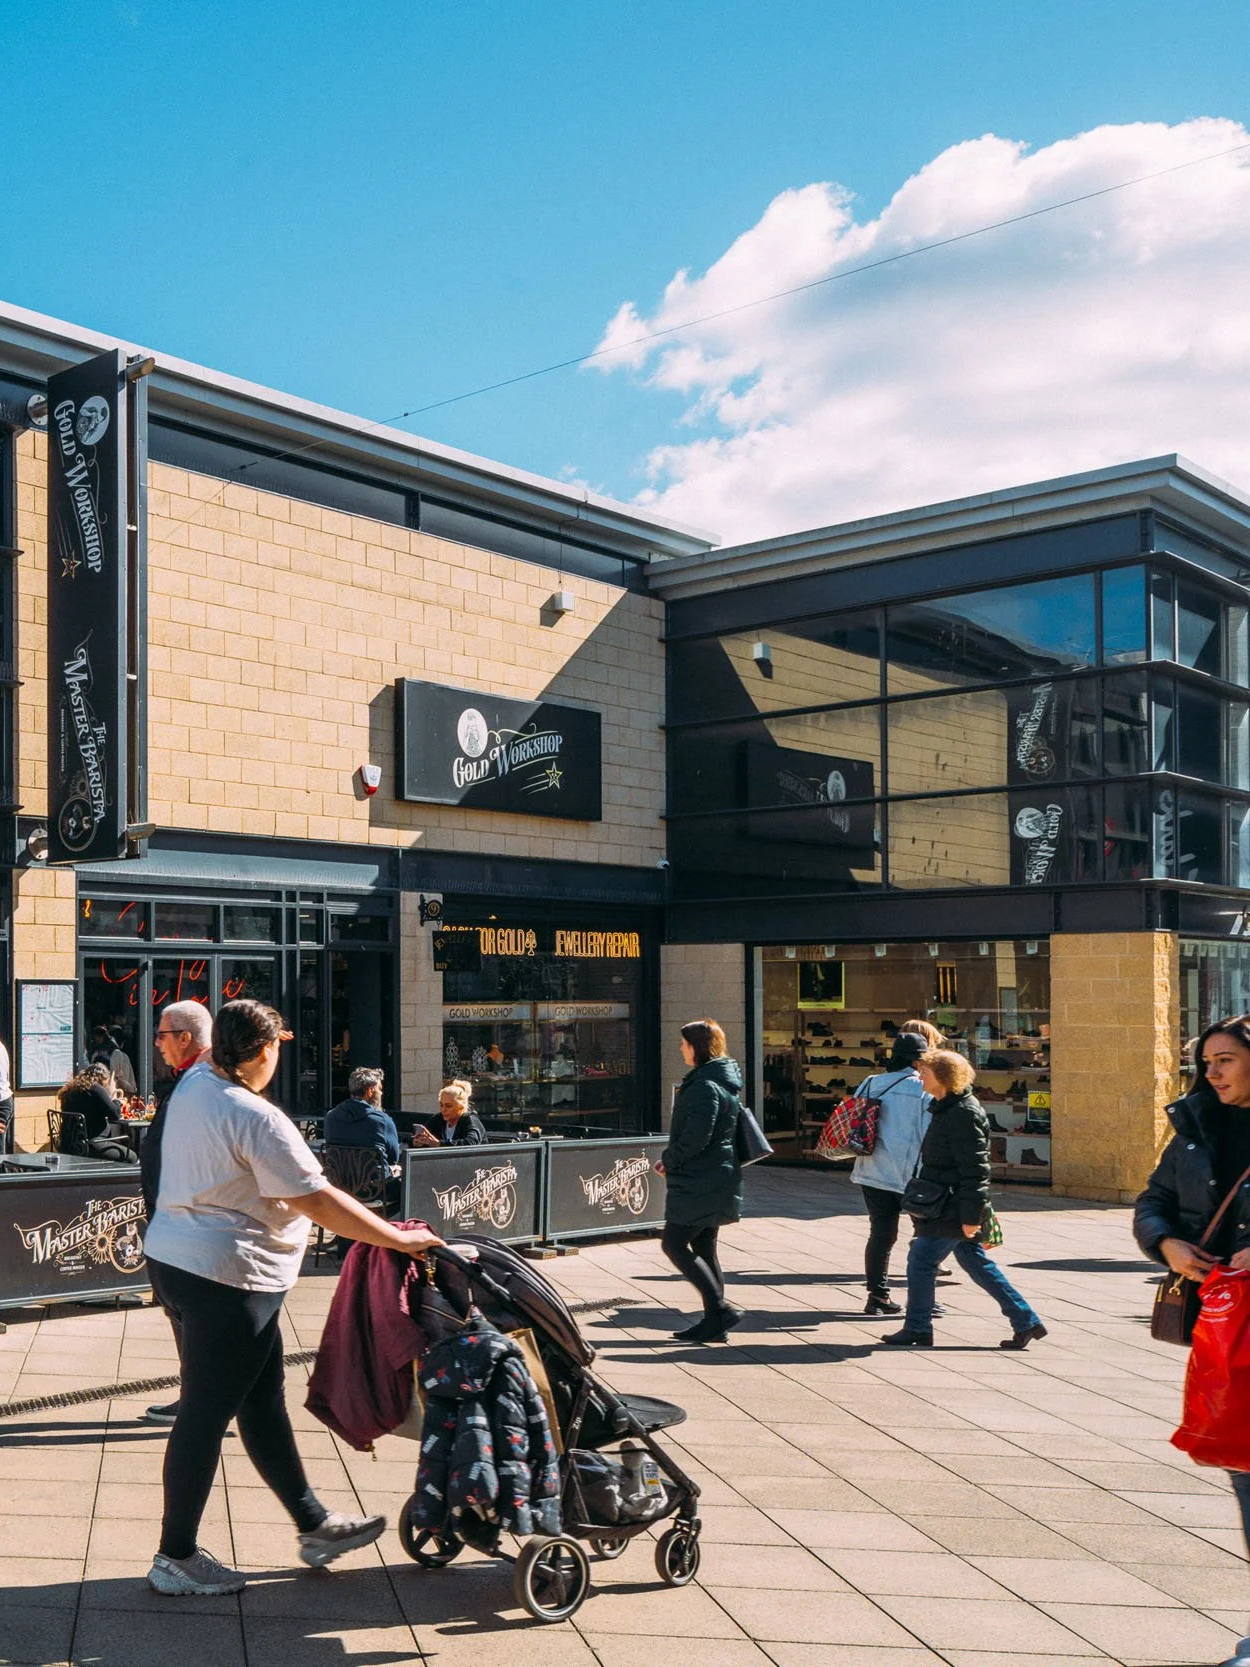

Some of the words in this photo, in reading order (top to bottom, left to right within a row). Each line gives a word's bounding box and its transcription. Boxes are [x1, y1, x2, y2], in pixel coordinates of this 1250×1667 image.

[54, 400, 76, 456] GOLD
[64, 453, 102, 574] WORKSHOP
[63, 647, 89, 737] MASTER
[79, 736, 105, 824] BARISTA
[93, 721, 107, 745] THE
[452, 757, 490, 789] GOLD
[490, 734, 563, 778] WORKSHOP
[497, 929, 525, 955] GOLD
[554, 930, 606, 957] JEWELLERY
[606, 932, 640, 957] REPAIR
[450, 1008, 470, 1019] GOLD
[472, 1007, 513, 1018] WORKSHOP
[555, 1006, 575, 1017] GOLD
[576, 1006, 612, 1017] WORKSHOP
[439, 1188, 480, 1221] MASTER
[480, 1166, 518, 1196] BARISTA
[585, 1176, 618, 1206] MASTER
[85, 1199, 103, 1219] THE
[25, 1222, 93, 1264] MASTER
